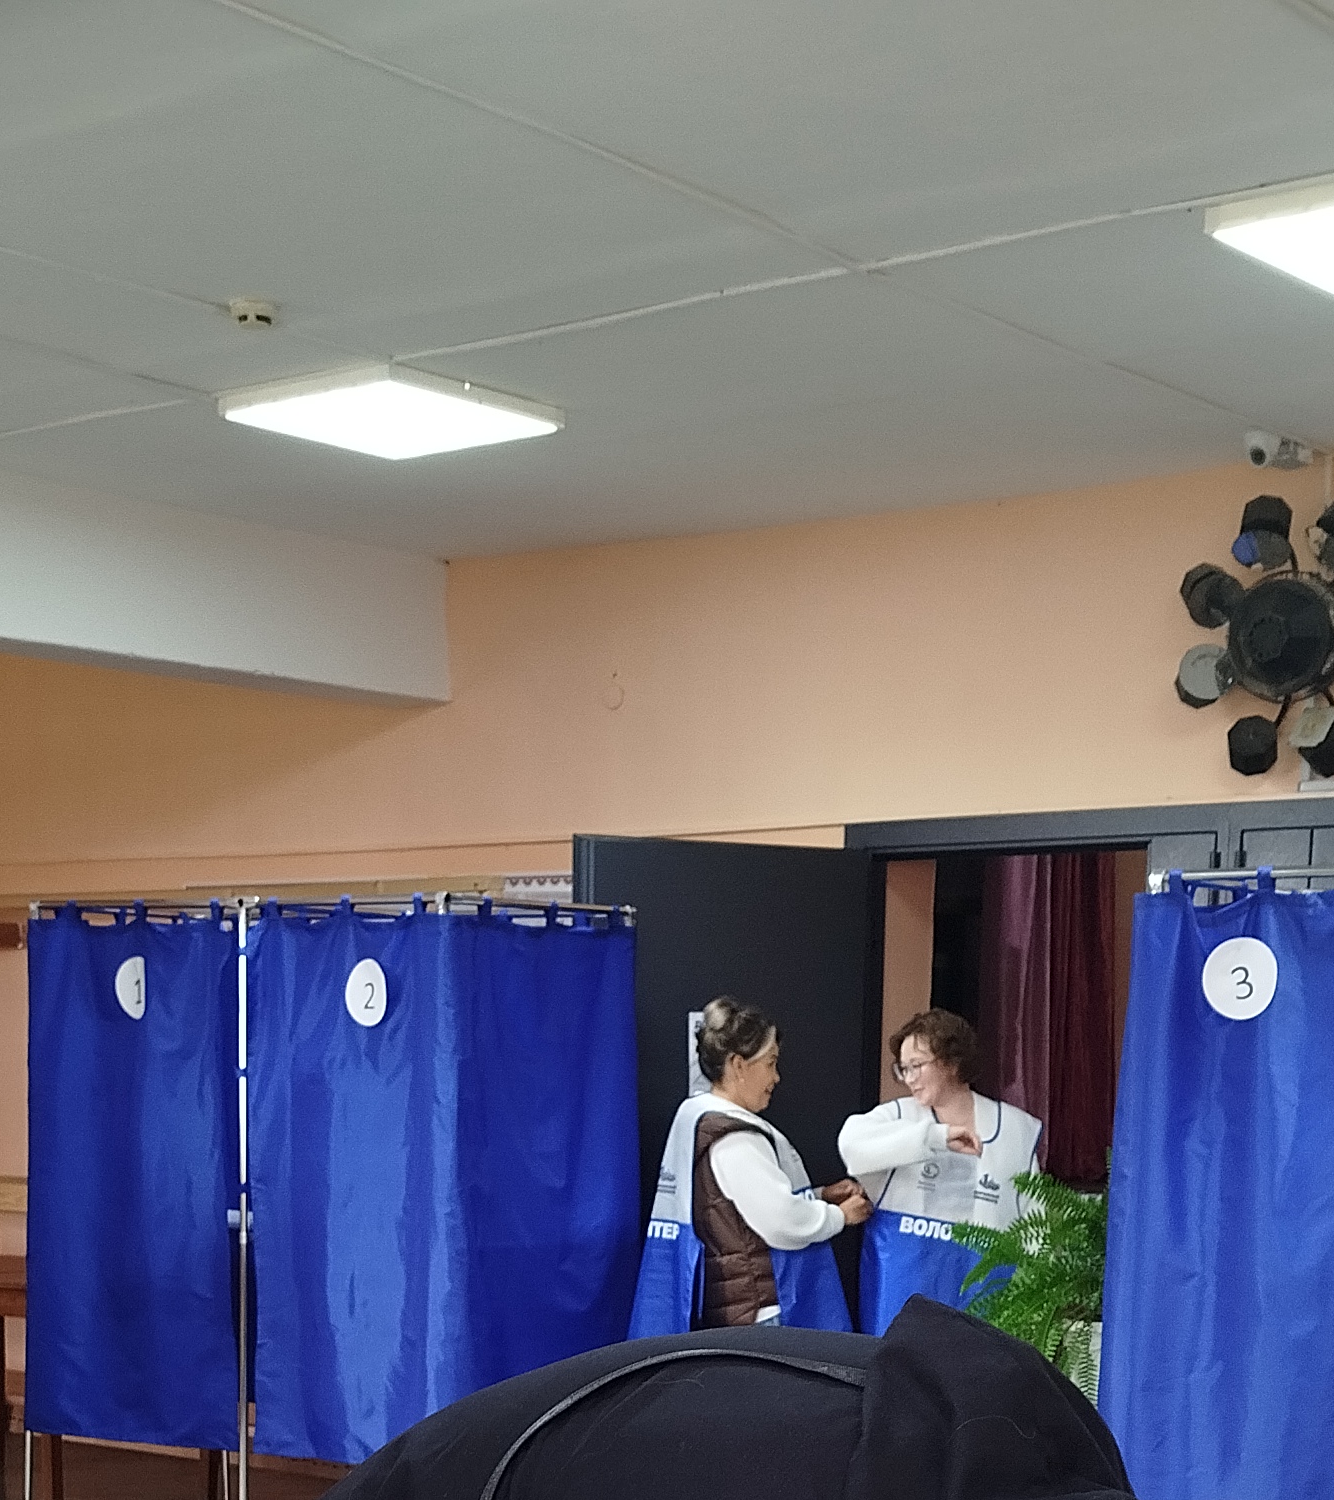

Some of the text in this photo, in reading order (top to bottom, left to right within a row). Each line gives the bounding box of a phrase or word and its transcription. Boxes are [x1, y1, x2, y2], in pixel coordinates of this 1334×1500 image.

[134, 979, 142, 1005] 1
[364, 982, 375, 1010] 2
[1230, 966, 1254, 1000] 3
